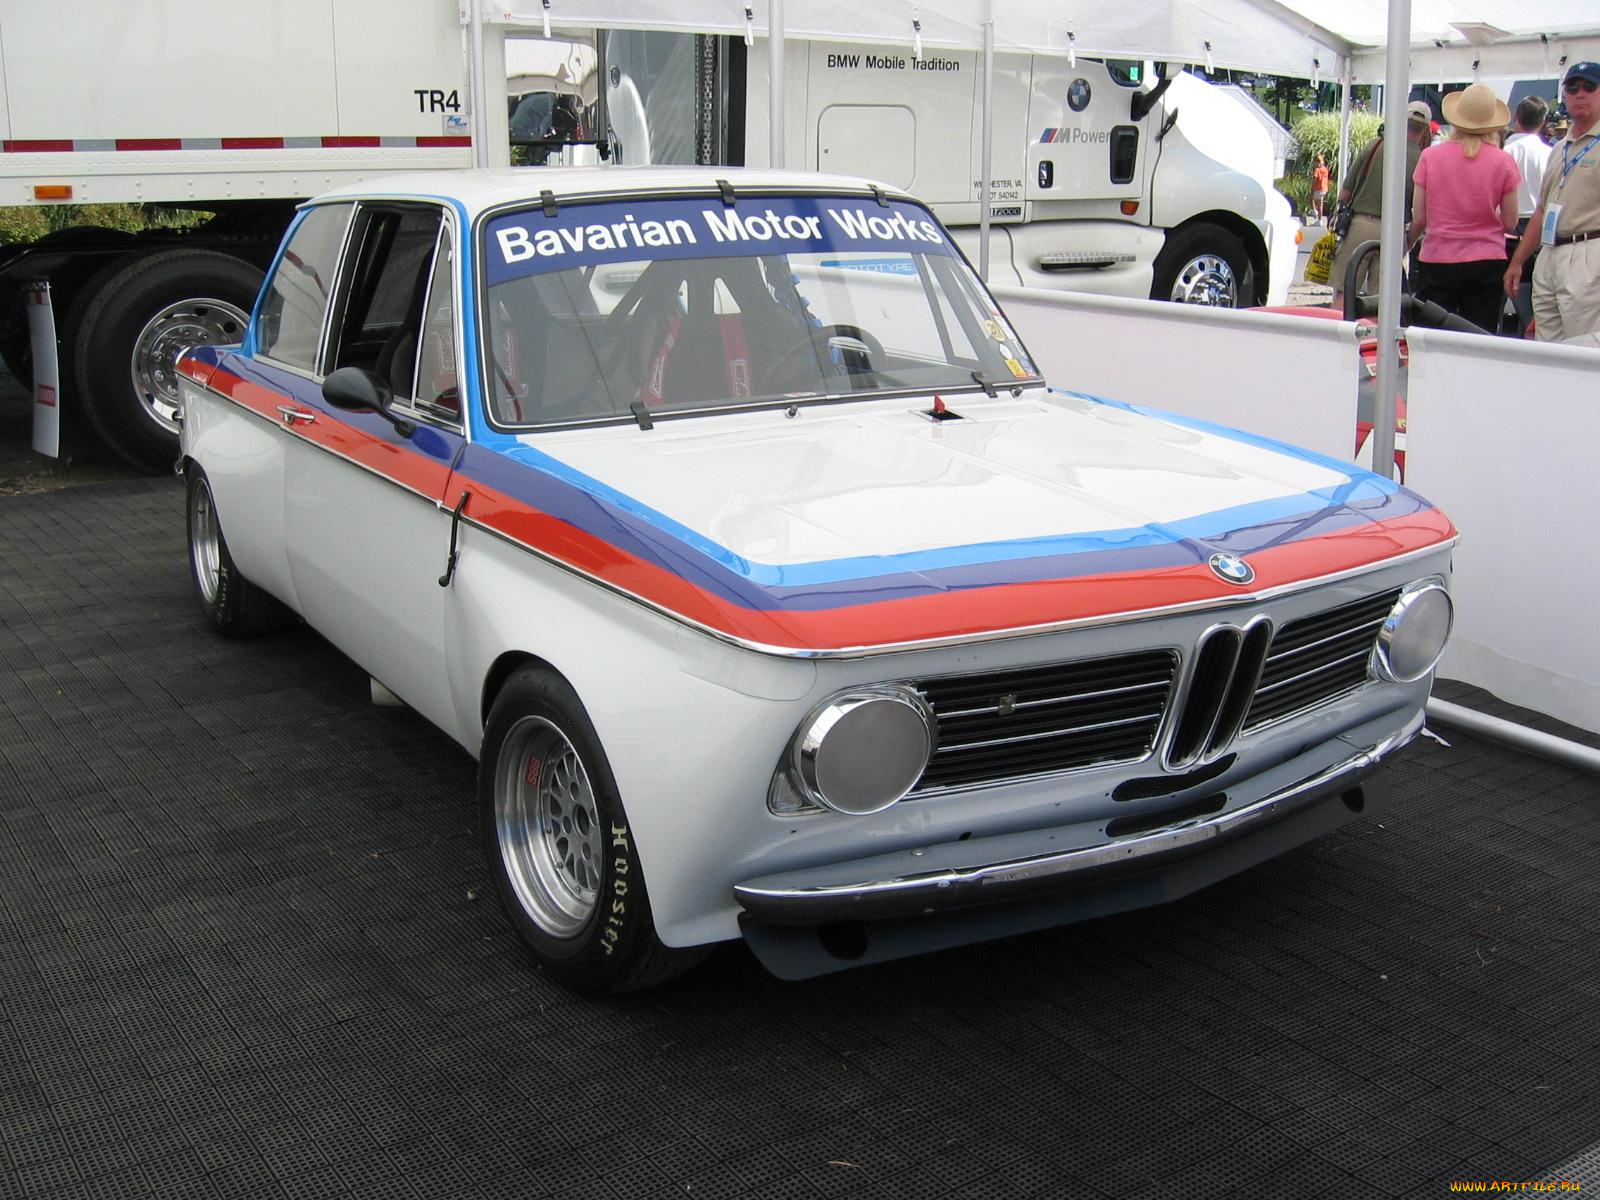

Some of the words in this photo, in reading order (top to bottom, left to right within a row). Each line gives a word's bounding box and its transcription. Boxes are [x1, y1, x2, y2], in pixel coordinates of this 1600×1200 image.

[827, 54, 860, 68] BMW
[865, 55, 905, 70] Mobile
[910, 56, 960, 71] Tradition
[414, 90, 461, 112] TR4
[1073, 127, 1110, 144] Power
[496, 214, 697, 264] Bavarian
[702, 209, 823, 243] Motor
[827, 208, 943, 245] Works
[526, 755, 542, 788] BBS
[601, 820, 629, 955] Hoosier
